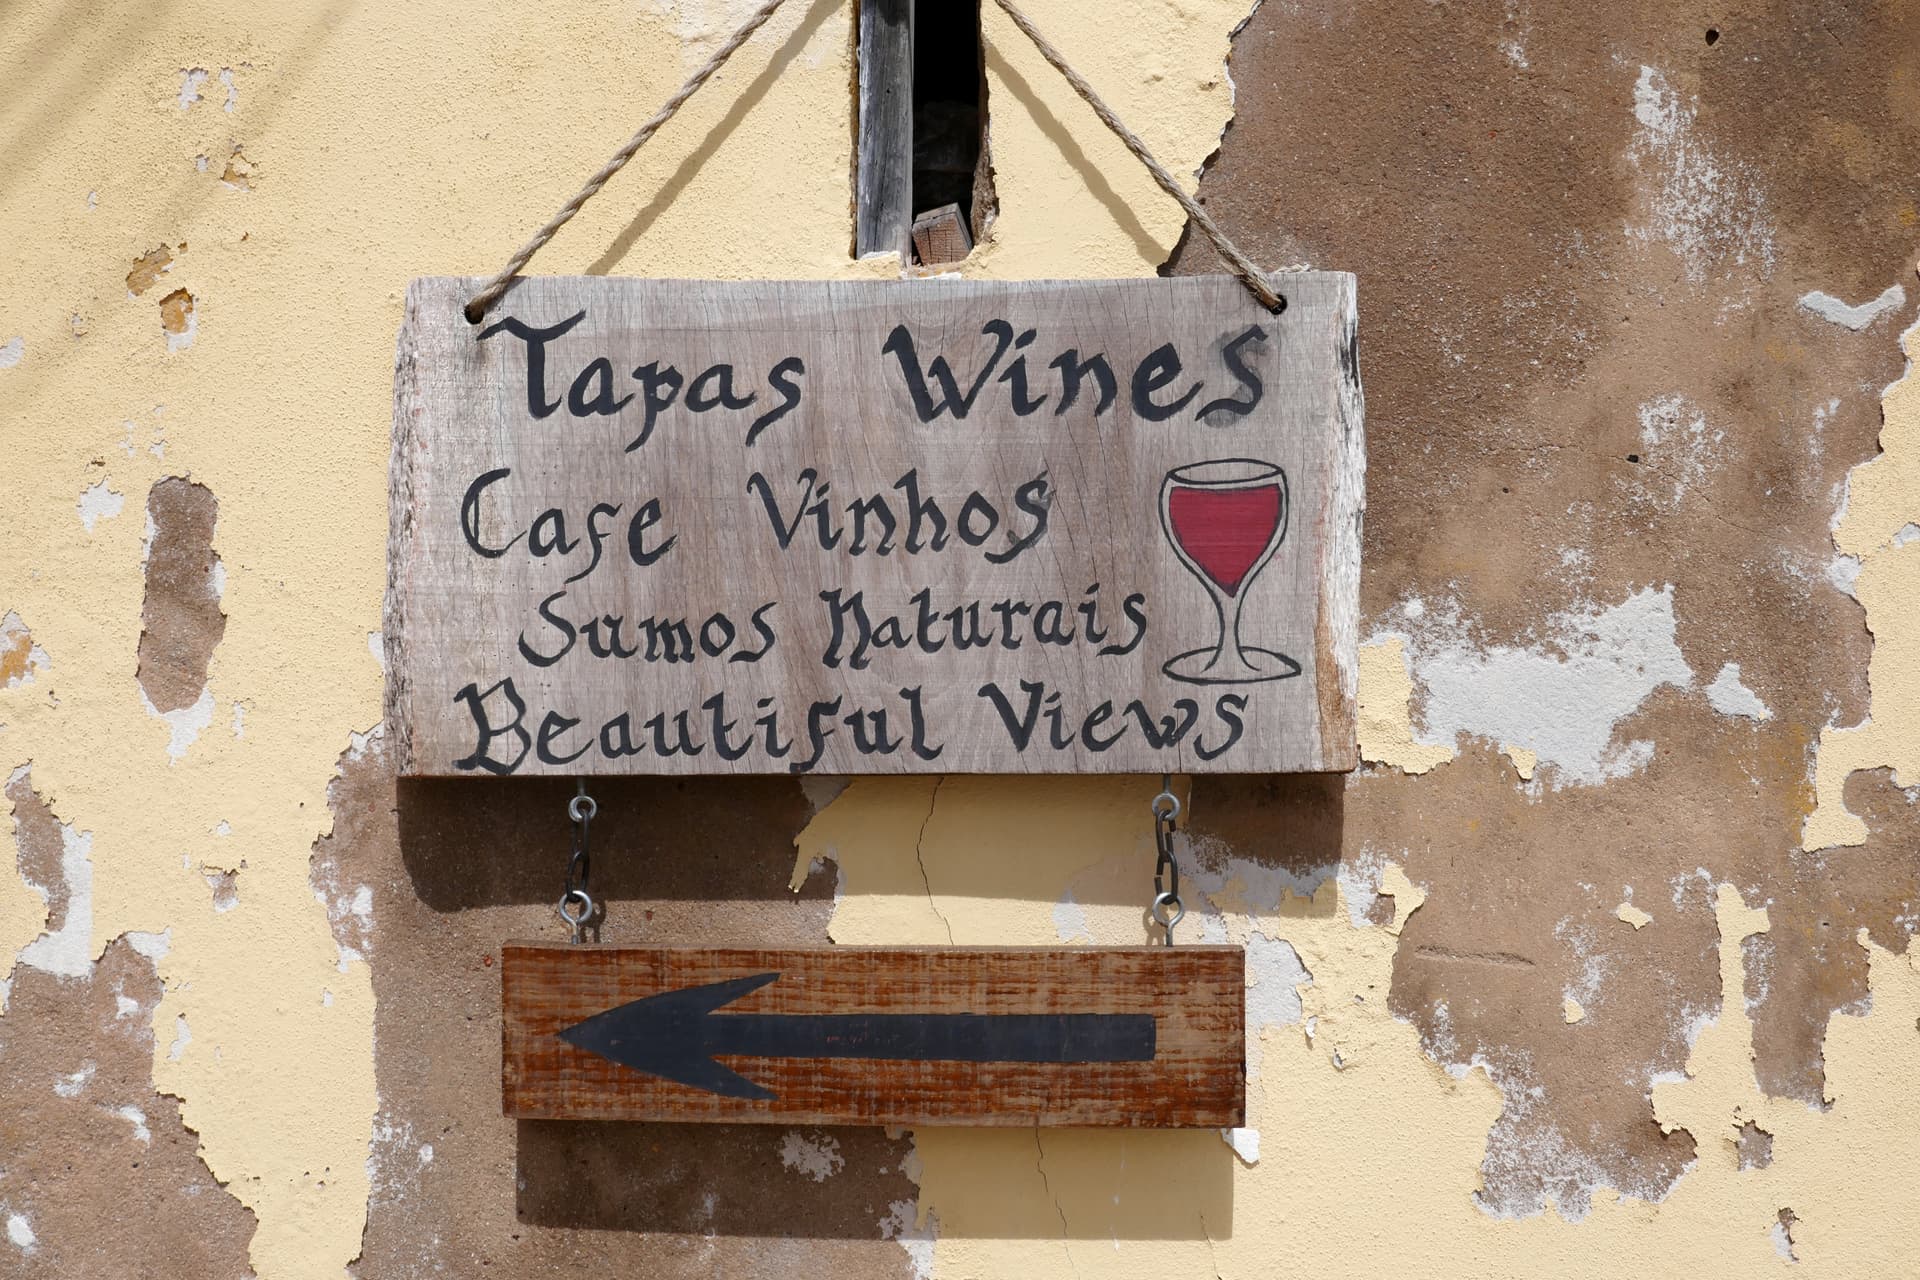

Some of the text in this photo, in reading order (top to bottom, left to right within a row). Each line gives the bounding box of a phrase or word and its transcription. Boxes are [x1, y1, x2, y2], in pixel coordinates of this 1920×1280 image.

[476, 308, 806, 454] Tapas
[461, 467, 1055, 585] Cafe Vinhos
[518, 583, 1148, 671] Sumos Naturais
[451, 677, 1249, 776] Beautiful Views
